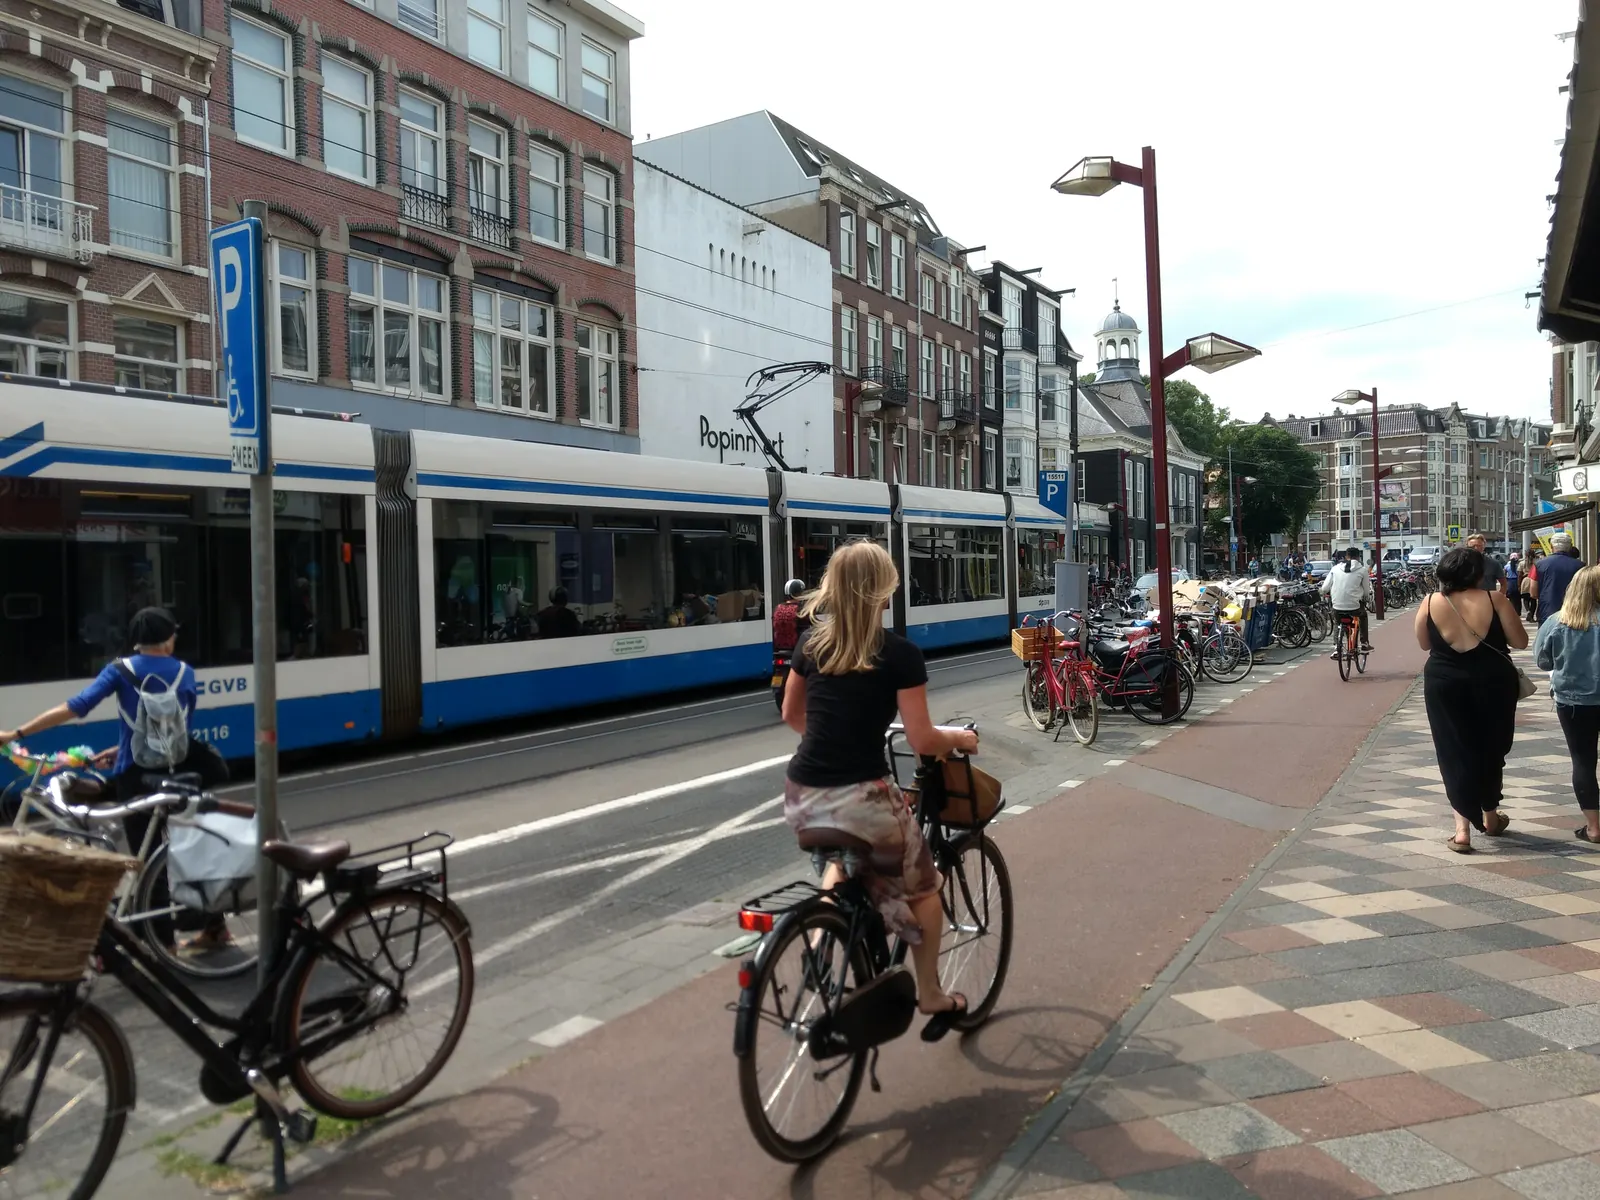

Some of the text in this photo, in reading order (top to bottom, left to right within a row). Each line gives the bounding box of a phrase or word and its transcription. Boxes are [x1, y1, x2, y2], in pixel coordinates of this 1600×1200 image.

[219, 246, 243, 348] P
[1047, 483, 1059, 501] P
[209, 678, 247, 694] GVB
[192, 725, 229, 742] 2116
